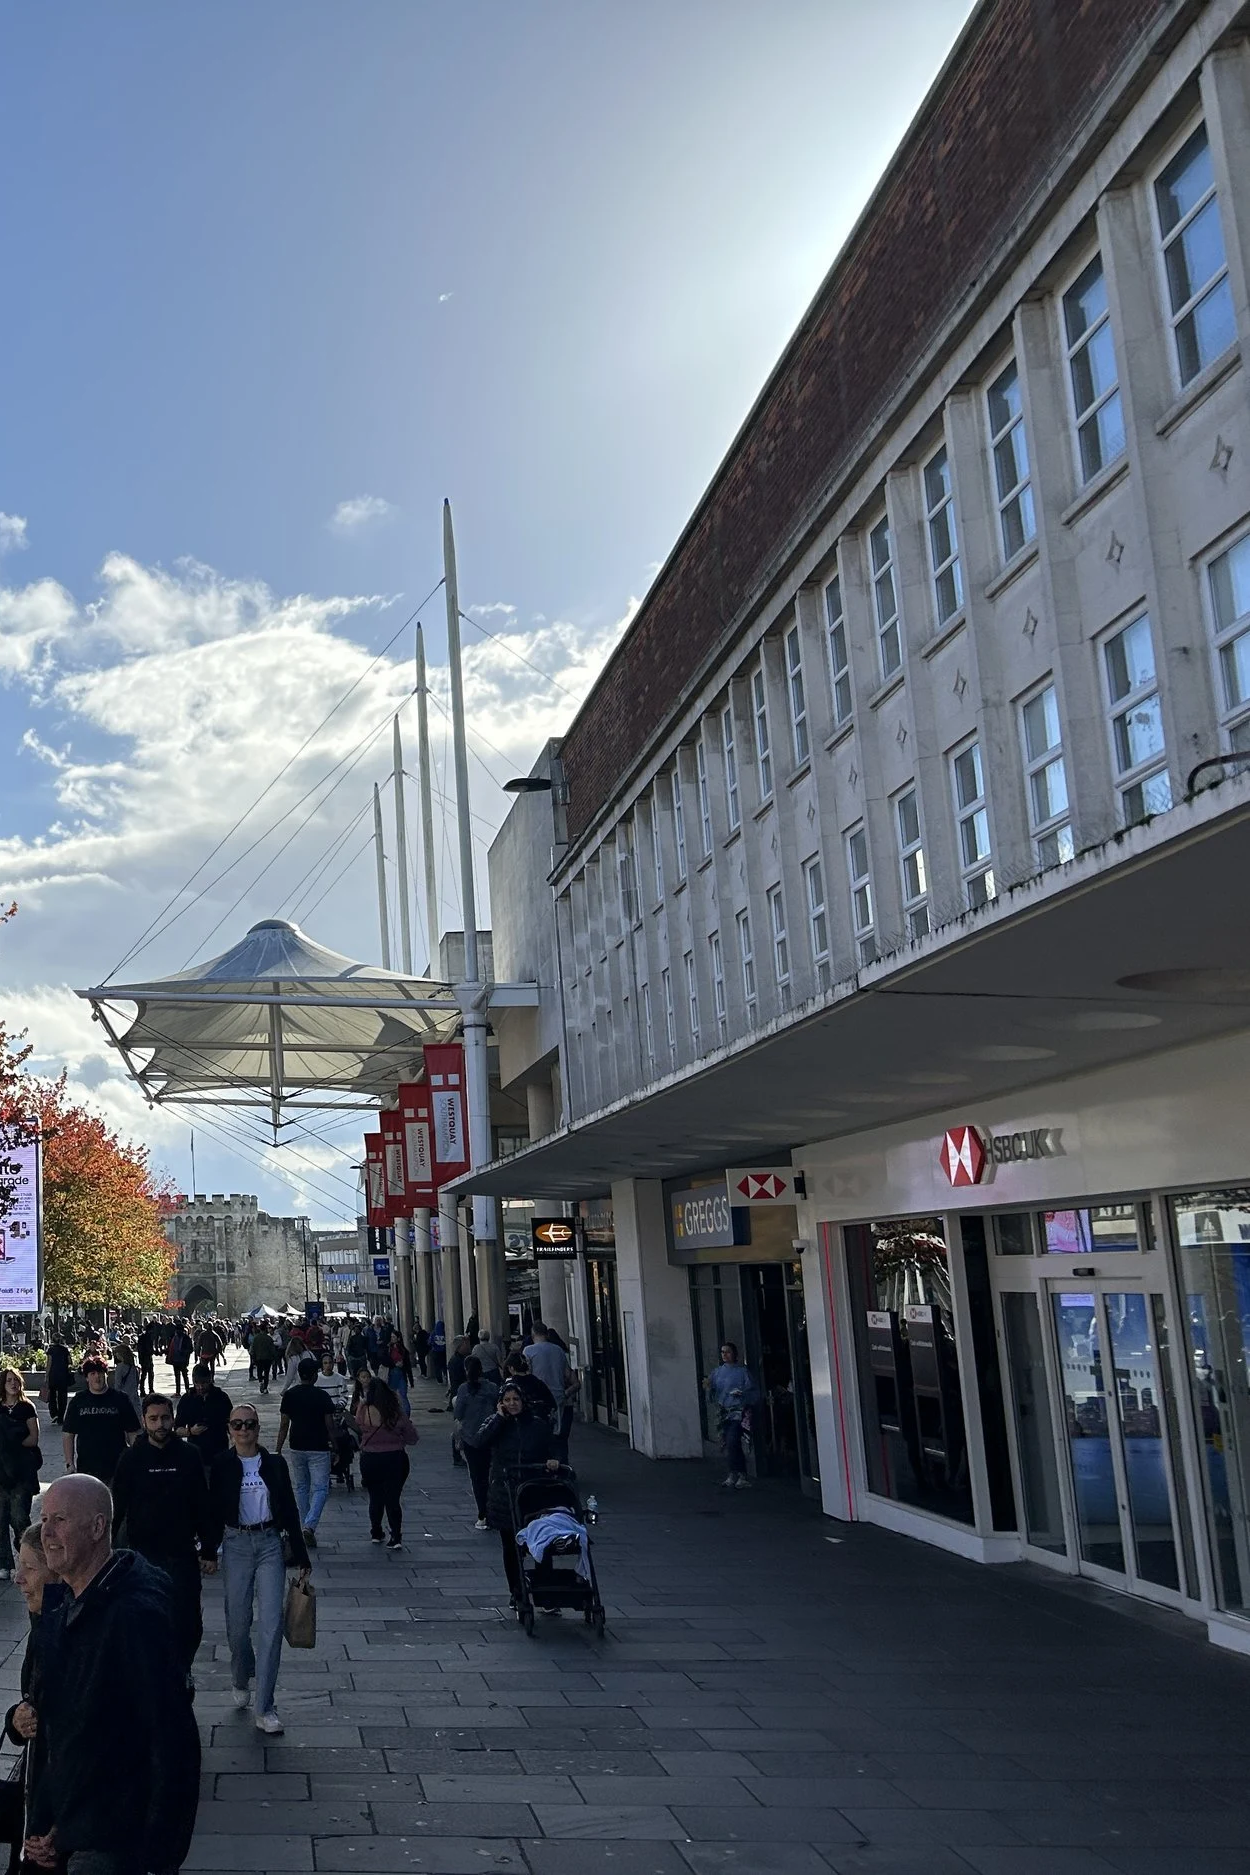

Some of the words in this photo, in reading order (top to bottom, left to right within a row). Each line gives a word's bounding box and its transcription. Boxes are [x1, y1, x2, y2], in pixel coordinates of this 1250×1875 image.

[447, 1097, 457, 1145] WESTQUAY
[417, 1128, 426, 1168] WESTQUAY
[983, 1133, 1023, 1165] HSBC
[684, 1195, 730, 1236] GREGGS
